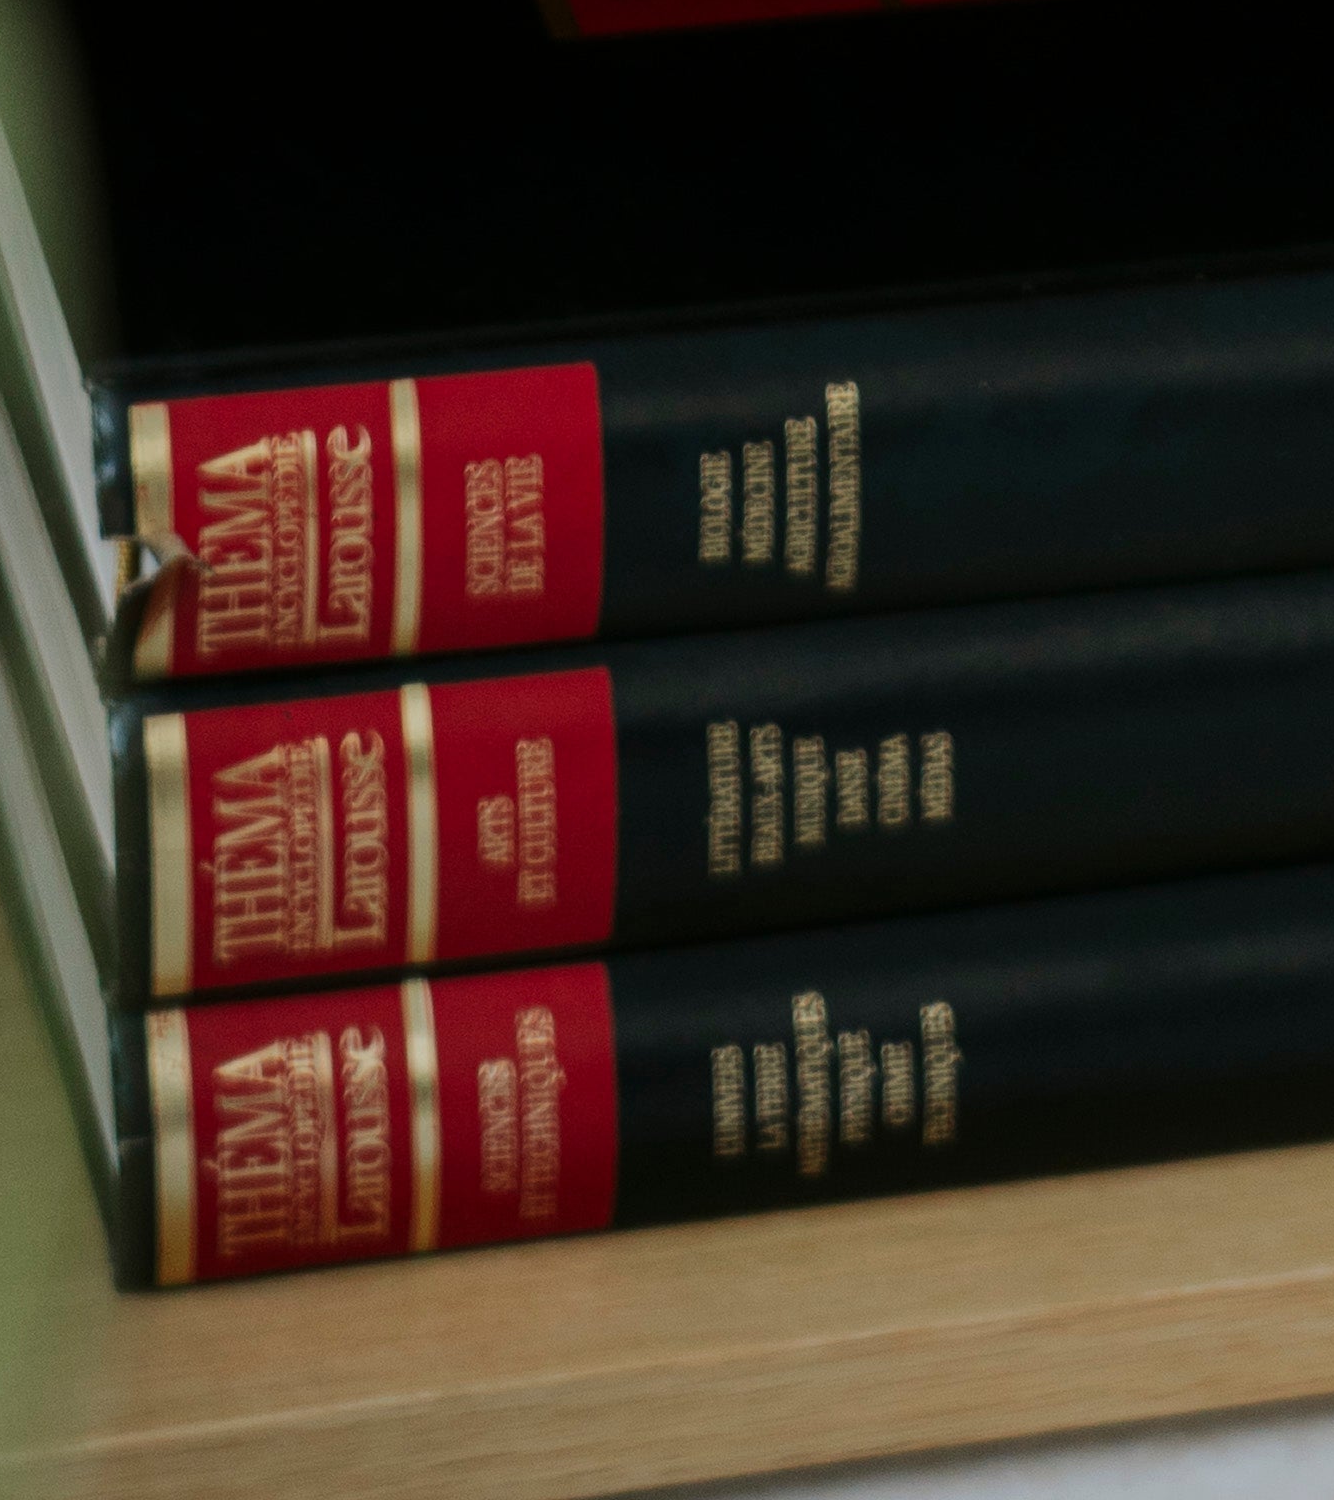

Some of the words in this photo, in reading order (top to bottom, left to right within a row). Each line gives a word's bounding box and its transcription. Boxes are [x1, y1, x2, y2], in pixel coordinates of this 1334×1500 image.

[319, 423, 372, 646] Larousse
[467, 459, 502, 597] SCIENCES
[506, 454, 541, 509] VIE
[507, 509, 542, 555] LA
[508, 555, 544, 595] DE
[200, 744, 286, 966] THÉMA
[333, 728, 387, 952] Larousse
[479, 795, 515, 866] ARTS
[516, 736, 555, 859] CULTURE
